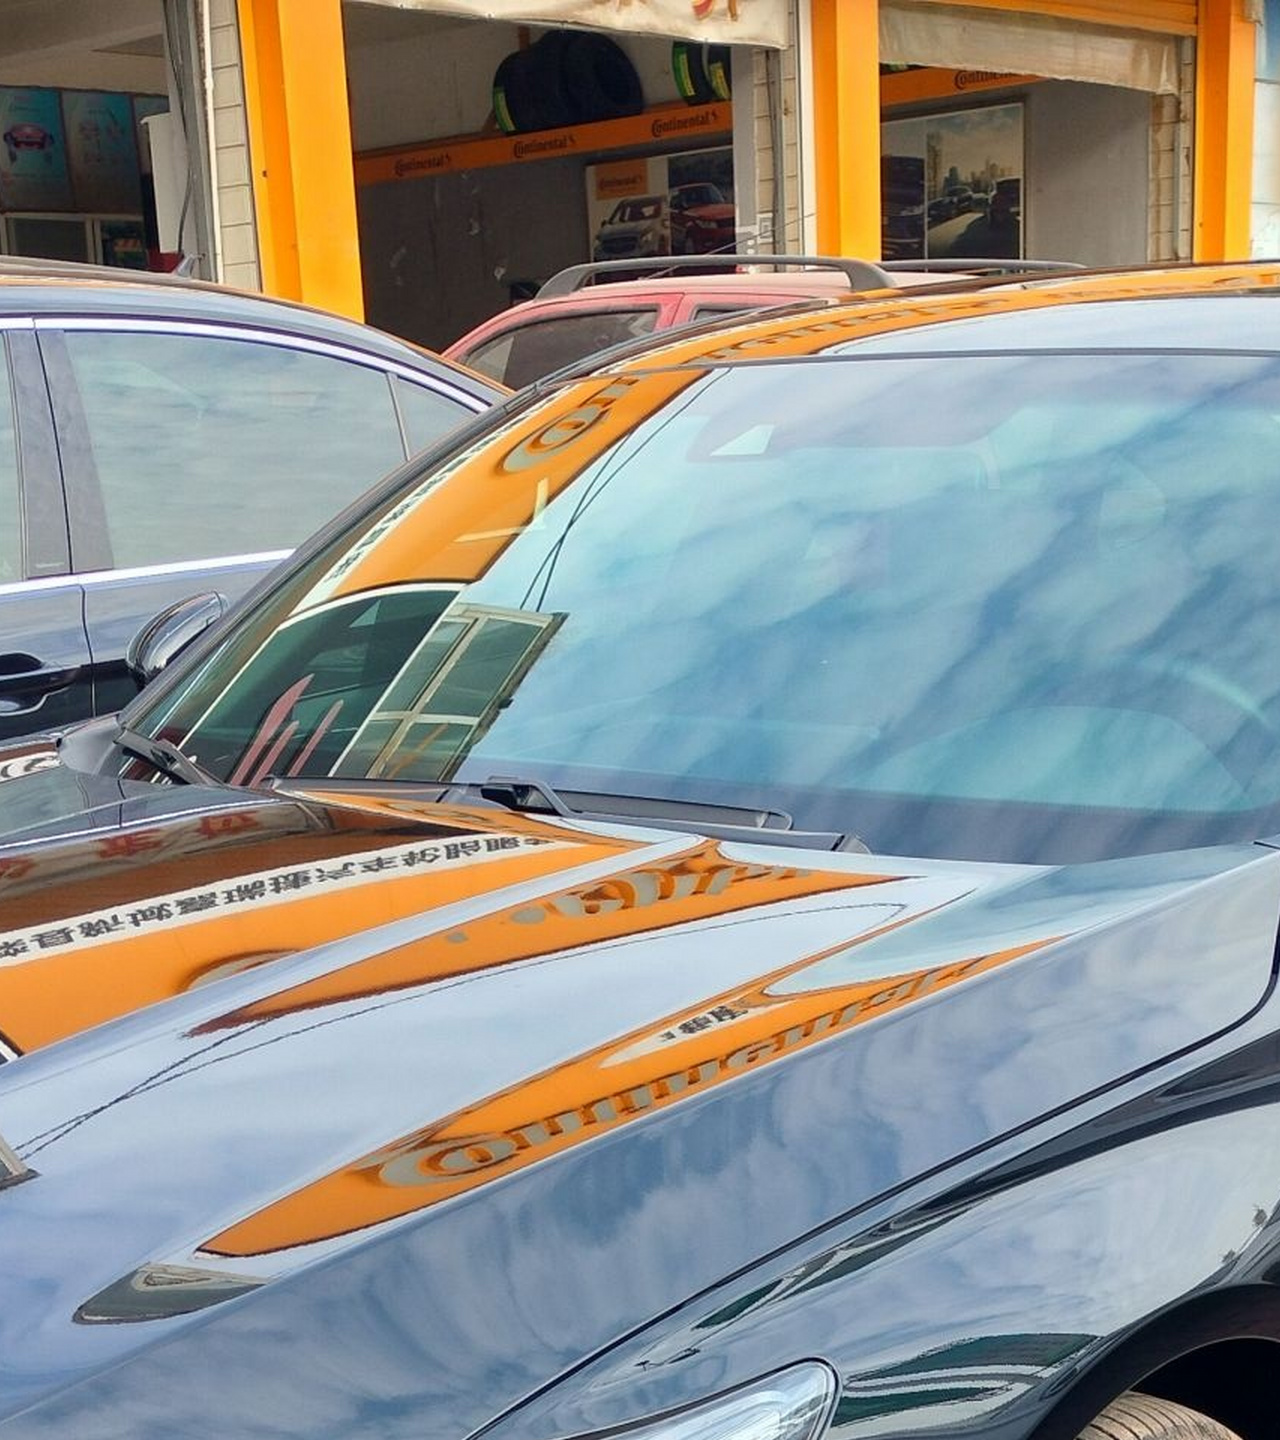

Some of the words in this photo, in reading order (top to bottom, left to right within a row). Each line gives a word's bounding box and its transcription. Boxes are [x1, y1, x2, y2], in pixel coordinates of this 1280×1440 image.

[652, 110, 711, 138] Continental
[513, 136, 568, 158] Continental
[394, 153, 445, 177] Continental
